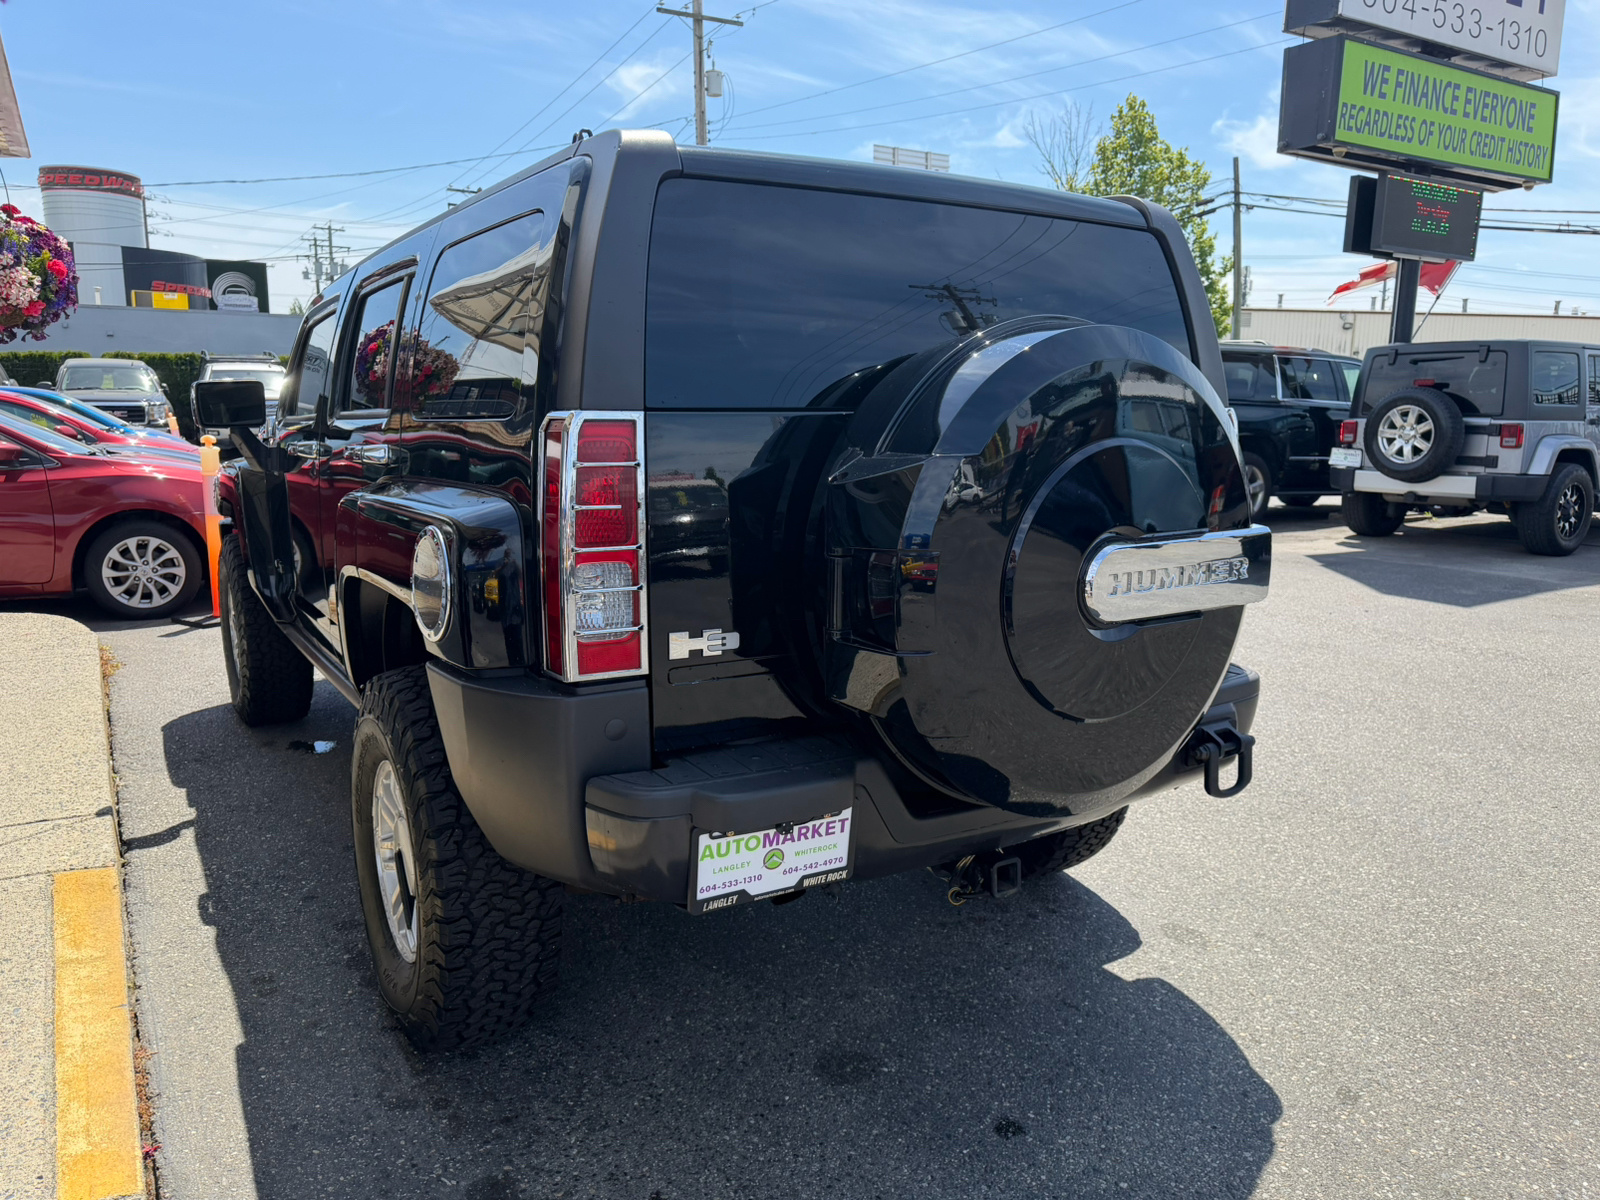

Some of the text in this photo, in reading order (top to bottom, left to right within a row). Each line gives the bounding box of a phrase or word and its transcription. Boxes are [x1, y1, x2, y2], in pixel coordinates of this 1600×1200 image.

[1367, 0, 1548, 58] 4-533-1310
[1363, 59, 1537, 133] WE FINANCE EVERYONE
[1338, 102, 1549, 171] REGARDLESS OF YOUR CREDIT HISTORY
[1107, 557, 1249, 598] HUMMER
[699, 817, 850, 862] AUTOMARKET
[794, 843, 838, 857] WHITEROCK
[712, 860, 752, 875] LANGLEY
[782, 856, 844, 876] 604-542-4970
[699, 873, 763, 895] 604-533-1310
[803, 869, 849, 888] WHITE ROCK
[702, 894, 739, 912] LANGLEY
